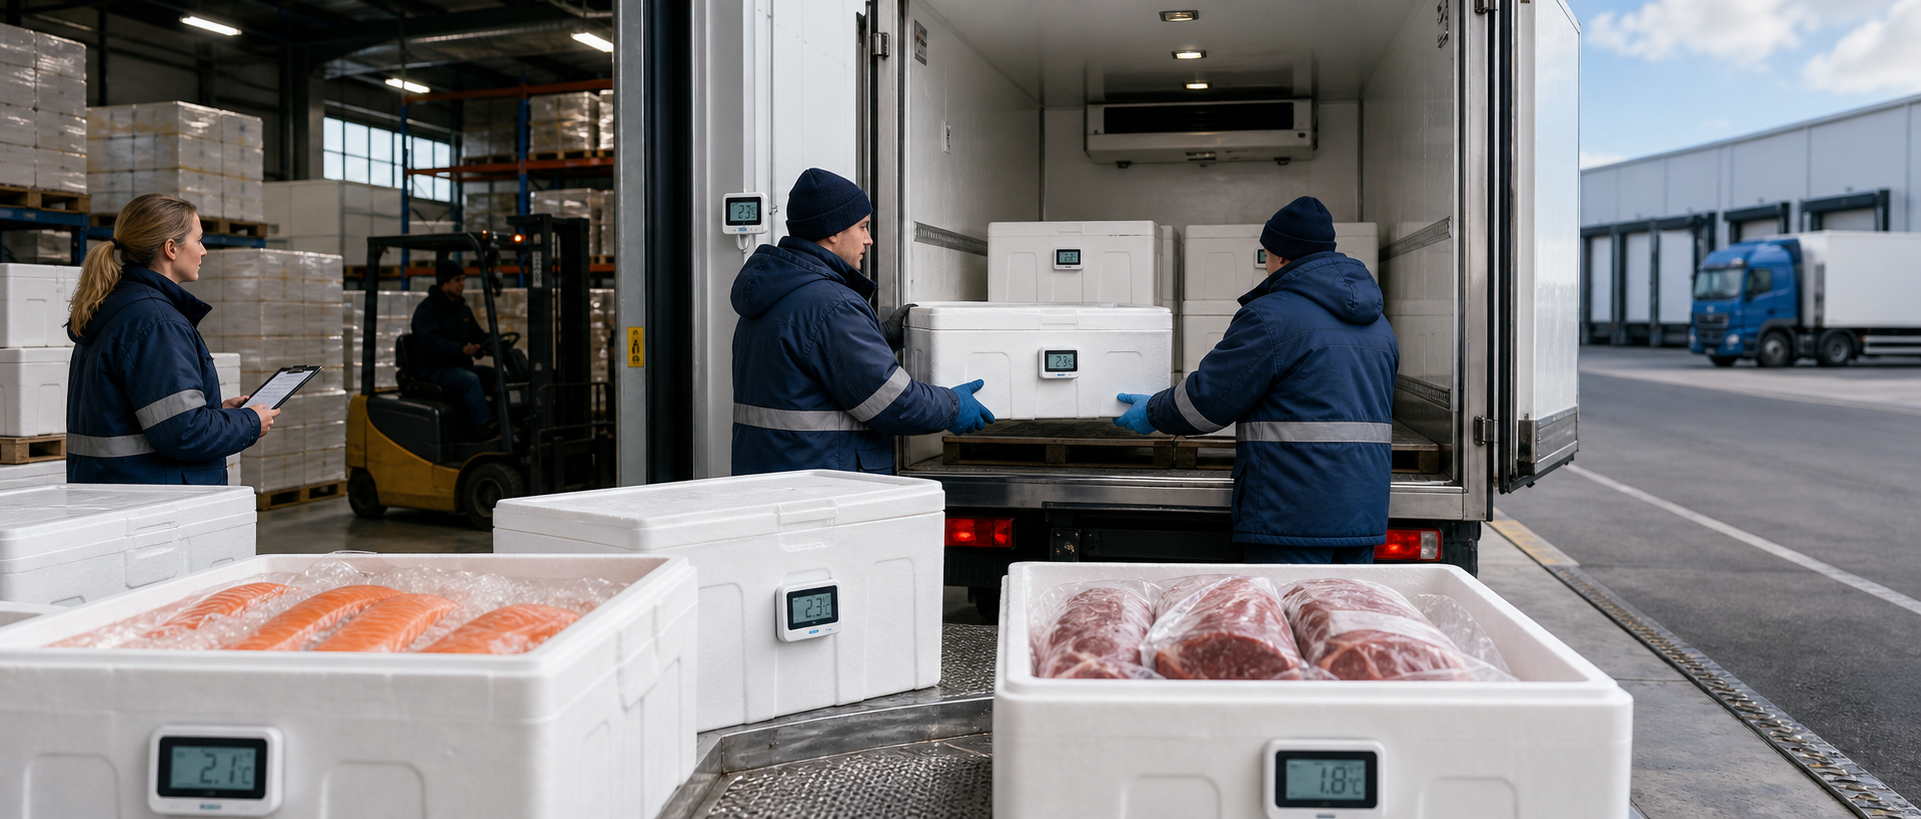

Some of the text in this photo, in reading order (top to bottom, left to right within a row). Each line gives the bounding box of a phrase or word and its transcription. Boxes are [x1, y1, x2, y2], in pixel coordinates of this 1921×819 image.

[805, 597, 830, 619] 2.3°C
[200, 753, 251, 785] 2.1°C
[1320, 766, 1362, 795] 1.8°C
